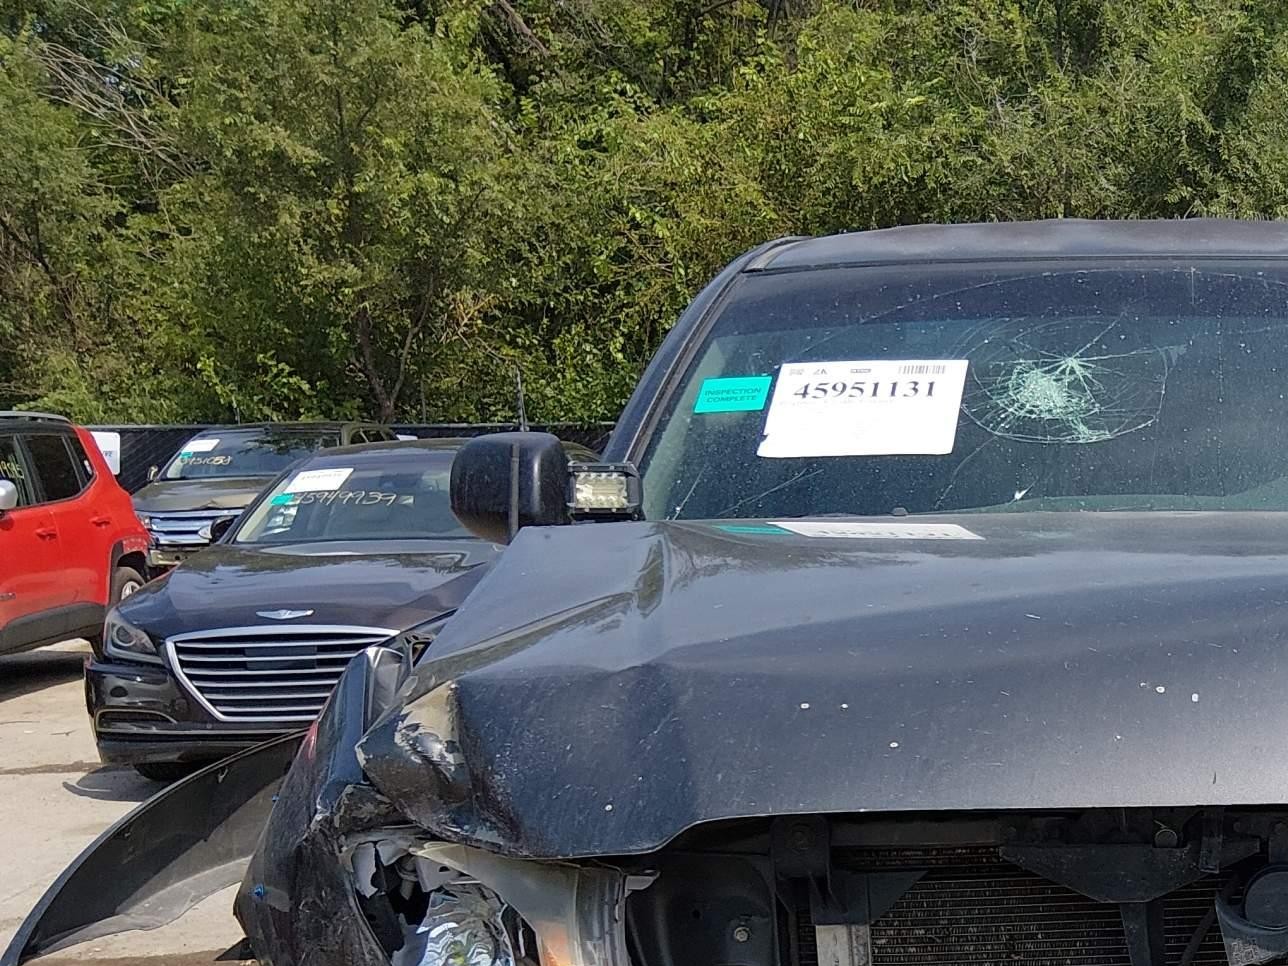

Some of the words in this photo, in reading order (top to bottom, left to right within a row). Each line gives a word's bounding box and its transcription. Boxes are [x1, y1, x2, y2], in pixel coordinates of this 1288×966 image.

[704, 387, 762, 396] INSPECTION
[793, 381, 935, 398] 45951131
[706, 395, 757, 403] COMPLETE
